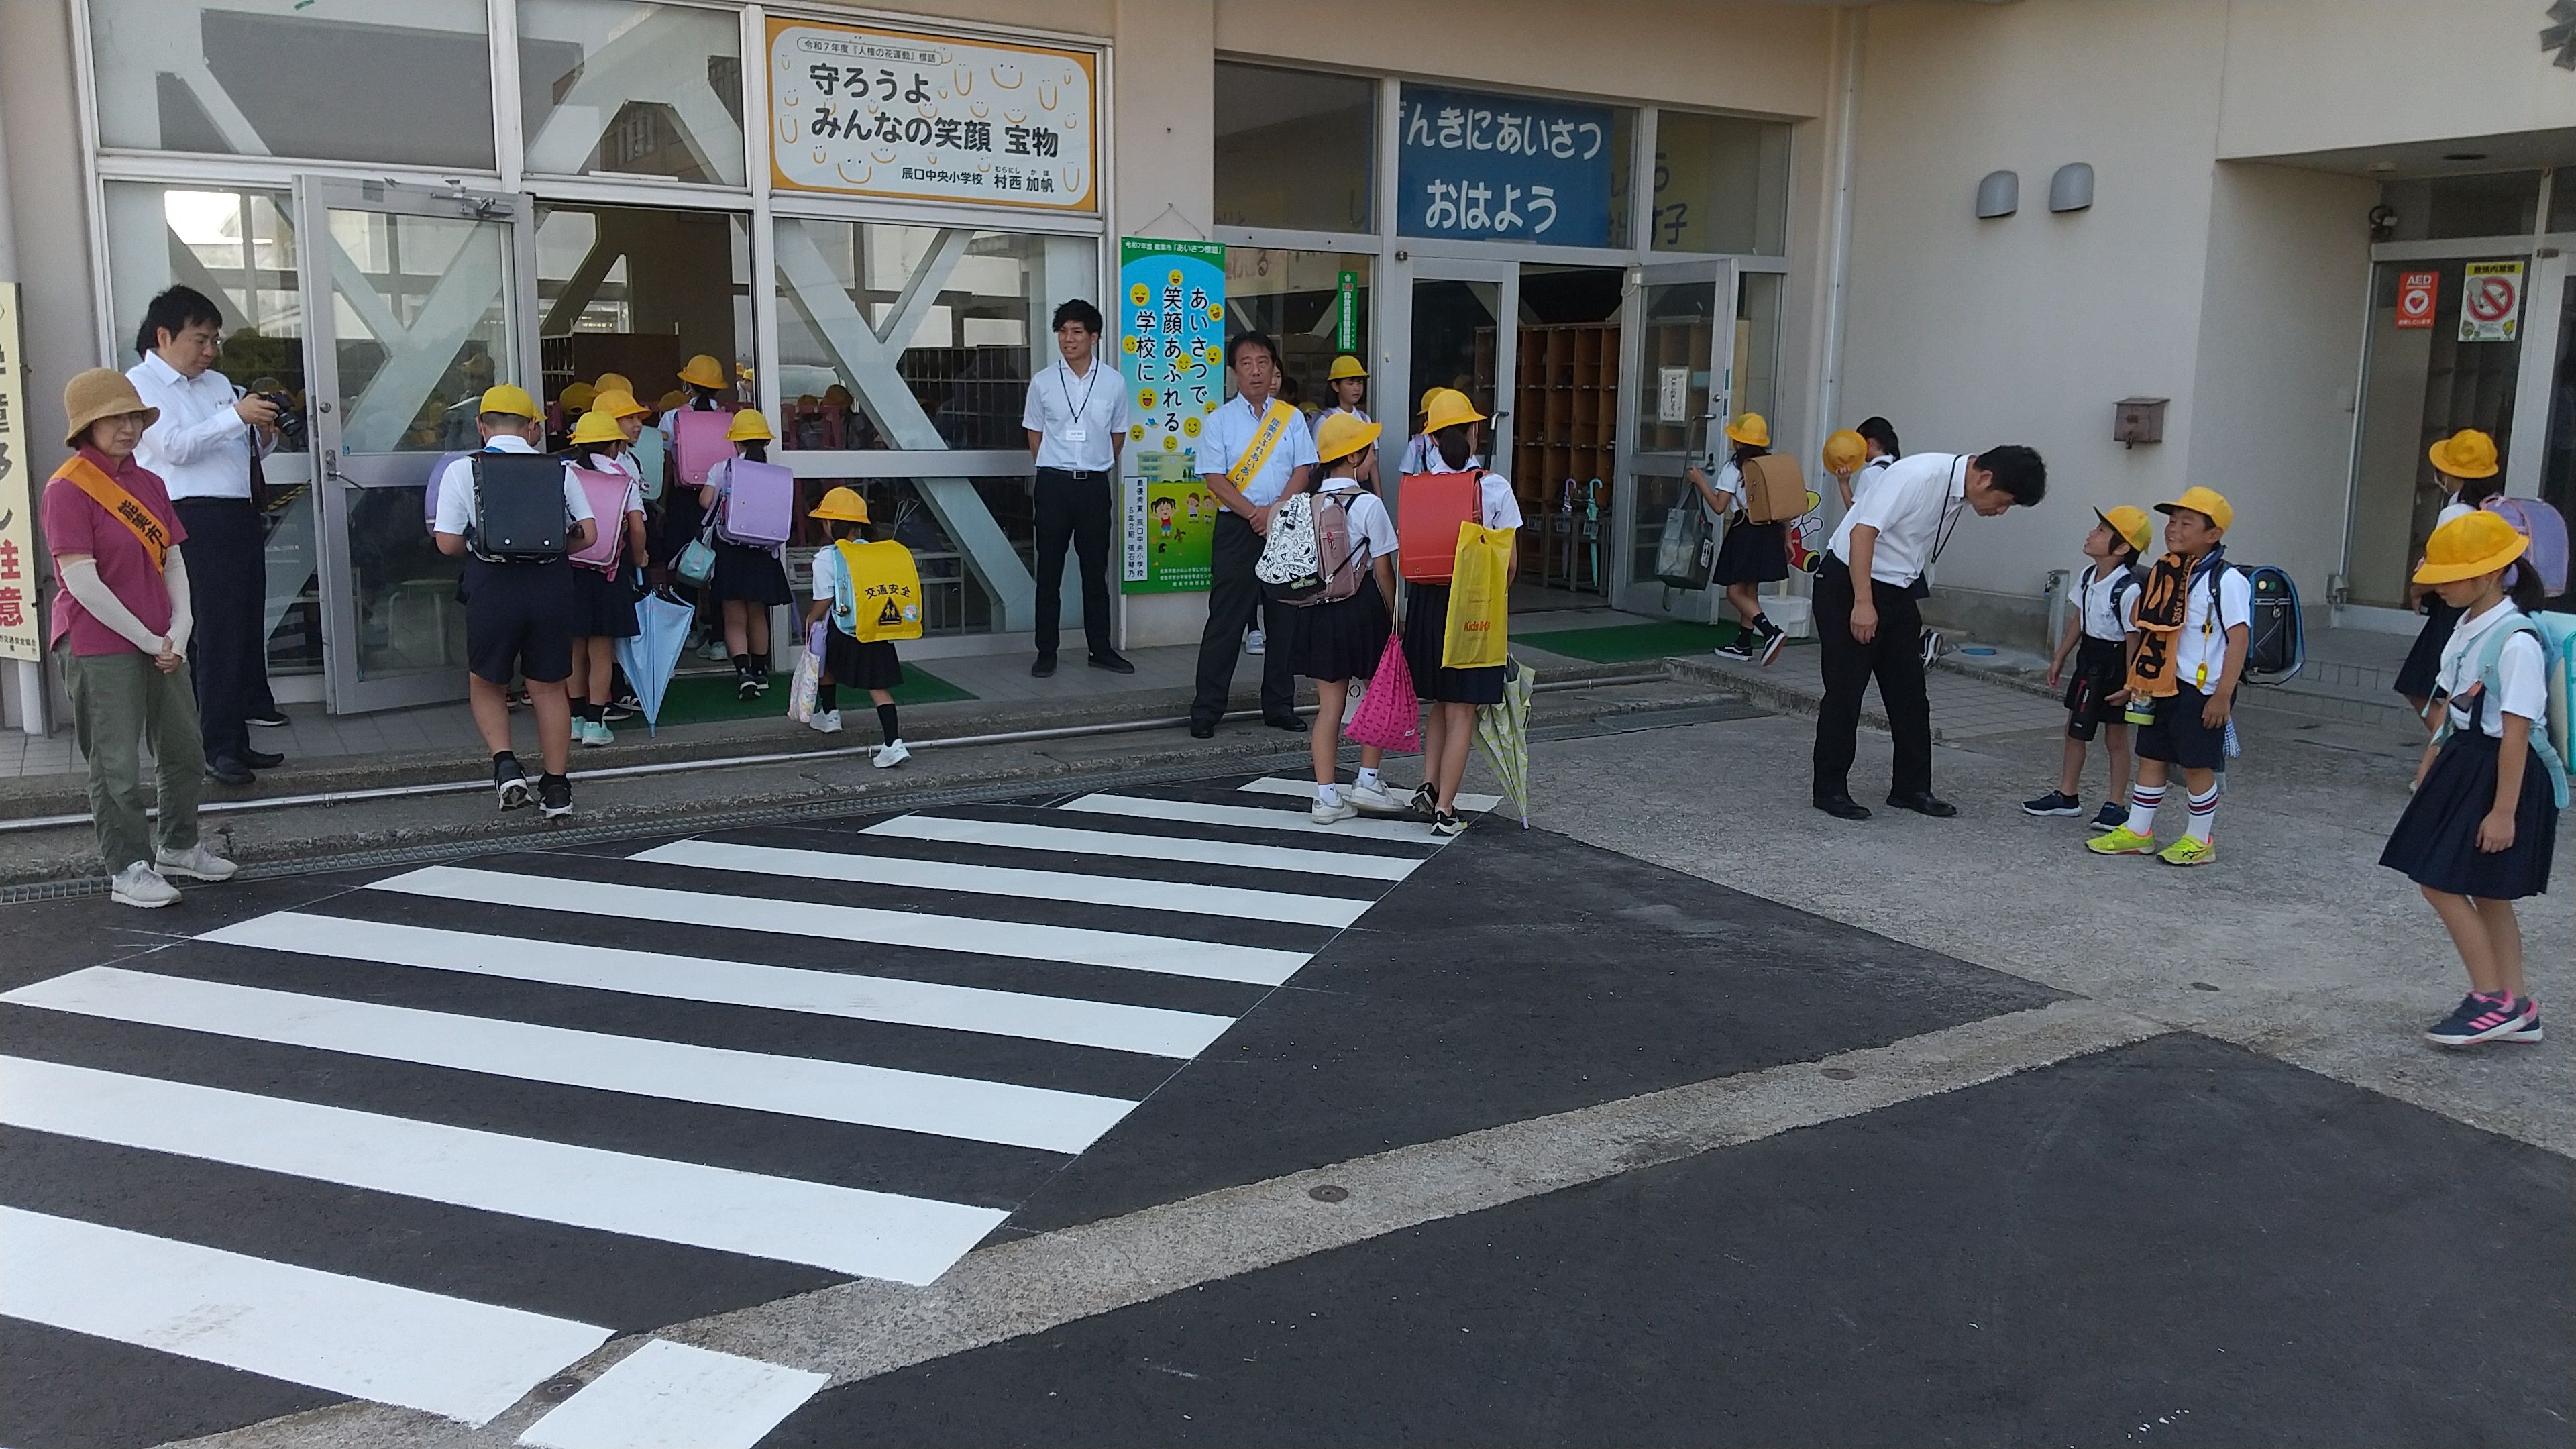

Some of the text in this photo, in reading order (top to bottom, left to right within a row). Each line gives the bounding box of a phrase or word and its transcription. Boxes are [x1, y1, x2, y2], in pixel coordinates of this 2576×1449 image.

[810, 63, 931, 104] 守ろうよ
[810, 107, 1060, 158] みんなの笑顔 宝物
[1399, 100, 1601, 160] んきにあいさつ
[902, 167, 1055, 193] 辰口中央小学校 村西 加帆
[995, 166, 1020, 174] むらにし
[1426, 179, 1557, 234] おはよう
[2406, 274, 2432, 284] AED
[1136, 311, 1156, 382] 学校に
[1163, 286, 1183, 432] 笑顔あふれる
[1190, 288, 1208, 404] あいさつで
[865, 584, 911, 600] 交通安全
